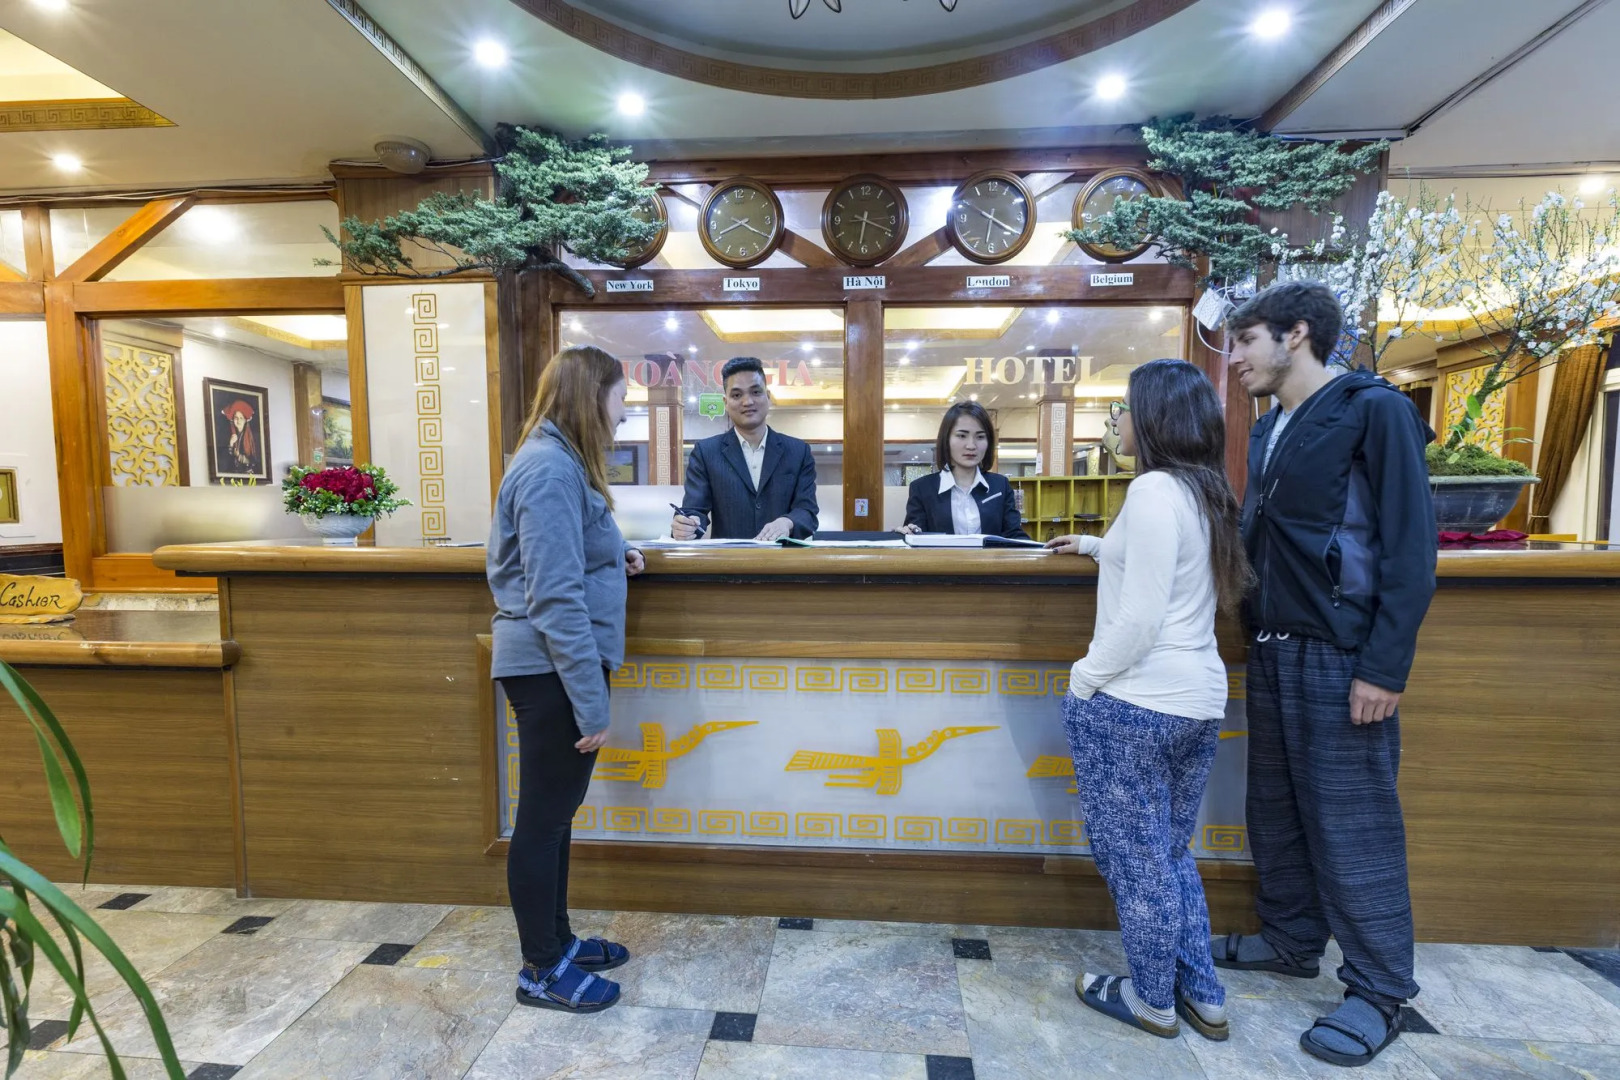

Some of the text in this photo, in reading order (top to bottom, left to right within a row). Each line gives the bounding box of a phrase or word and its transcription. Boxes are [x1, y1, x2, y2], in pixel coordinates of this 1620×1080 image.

[860, 185, 872, 196] 12
[987, 181, 999, 192] 12
[733, 188, 745, 199] 12
[764, 215, 771, 225] 3
[834, 215, 842, 225] 9
[889, 215, 896, 225] 3
[960, 213, 968, 223] 9
[710, 220, 718, 230] 9
[739, 246, 748, 256] 6
[860, 244, 868, 254] 6
[987, 242, 996, 253] 6
[607, 280, 654, 290] New York
[726, 278, 759, 291] Tokyo
[845, 276, 884, 288] Hà Nội
[967, 276, 1010, 287] London
[1092, 274, 1133, 285] Belgium
[963, 356, 1102, 385] HOTEL
